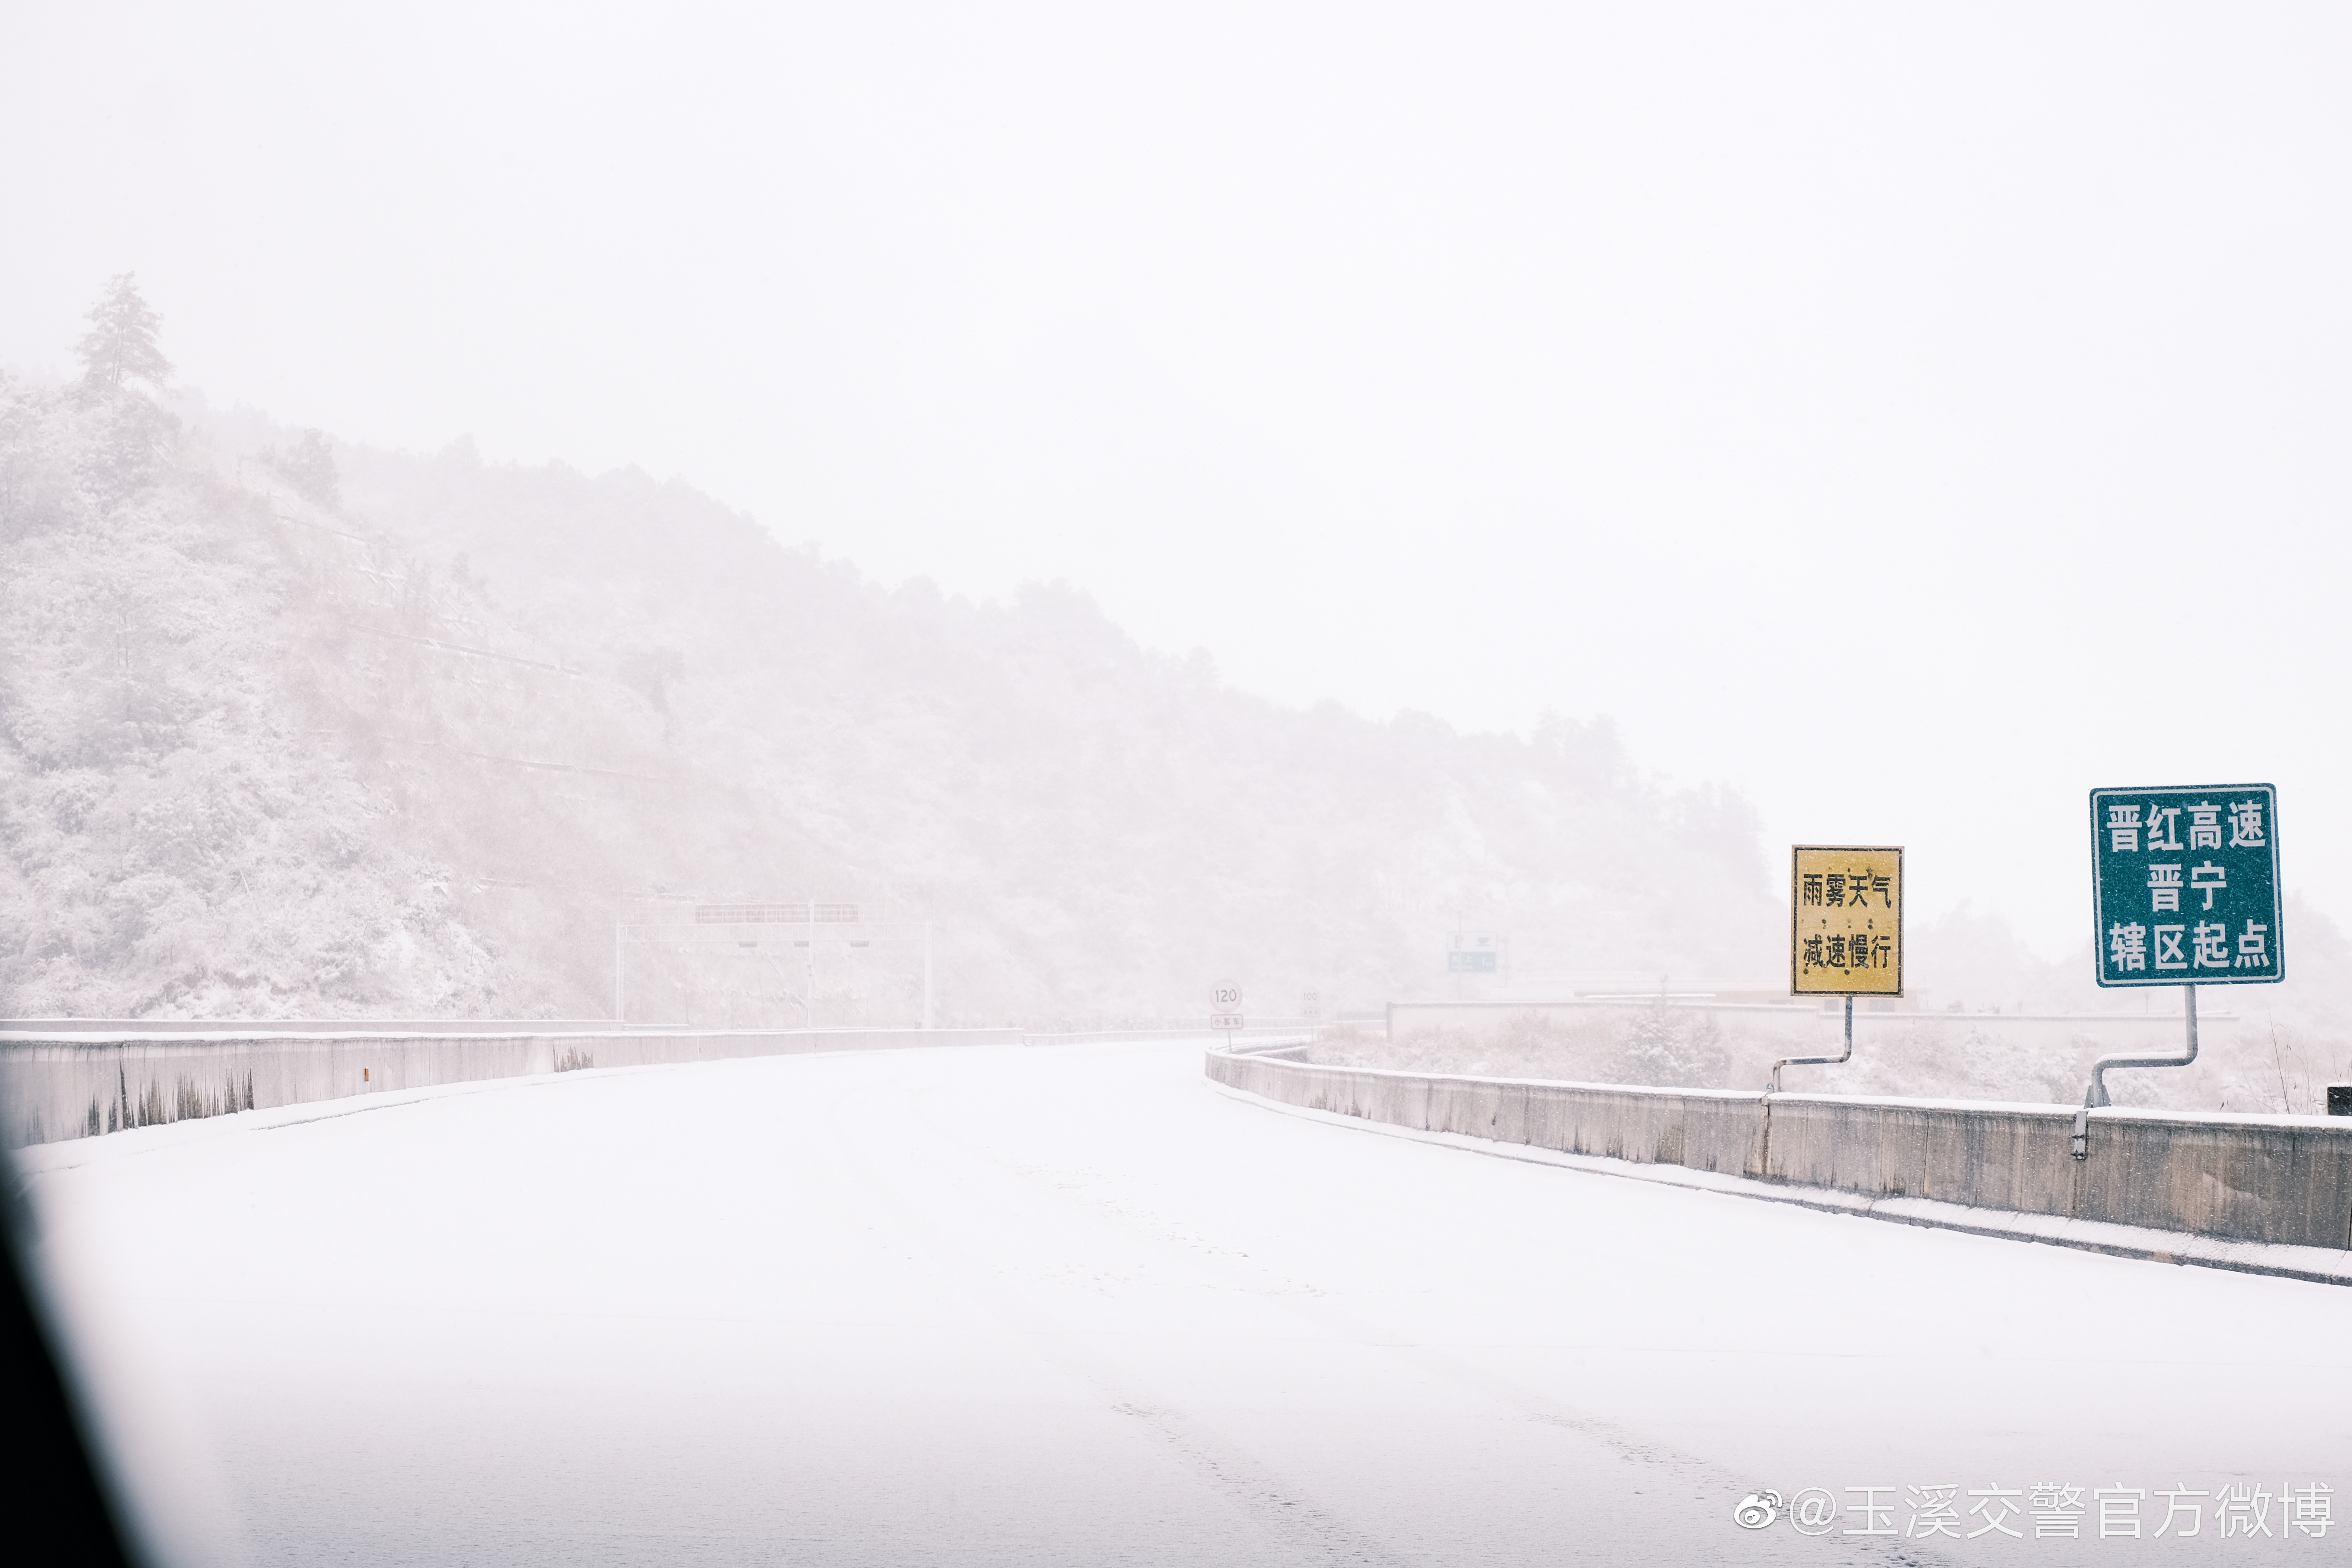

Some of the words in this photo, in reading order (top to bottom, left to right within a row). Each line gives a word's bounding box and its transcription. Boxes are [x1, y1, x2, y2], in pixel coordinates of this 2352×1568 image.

[2107, 799, 2266, 853] 晋红高速
[1803, 873, 1892, 908] 雨雾天气
[2147, 860, 2227, 912] 晋宁
[1803, 934, 1891, 968] 减速慢行
[2109, 919, 2269, 971] 辖区起点
[1215, 989, 1237, 1003] 120
[1303, 992, 1317, 1001] 100
[1214, 1017, 1240, 1026] 小客车
